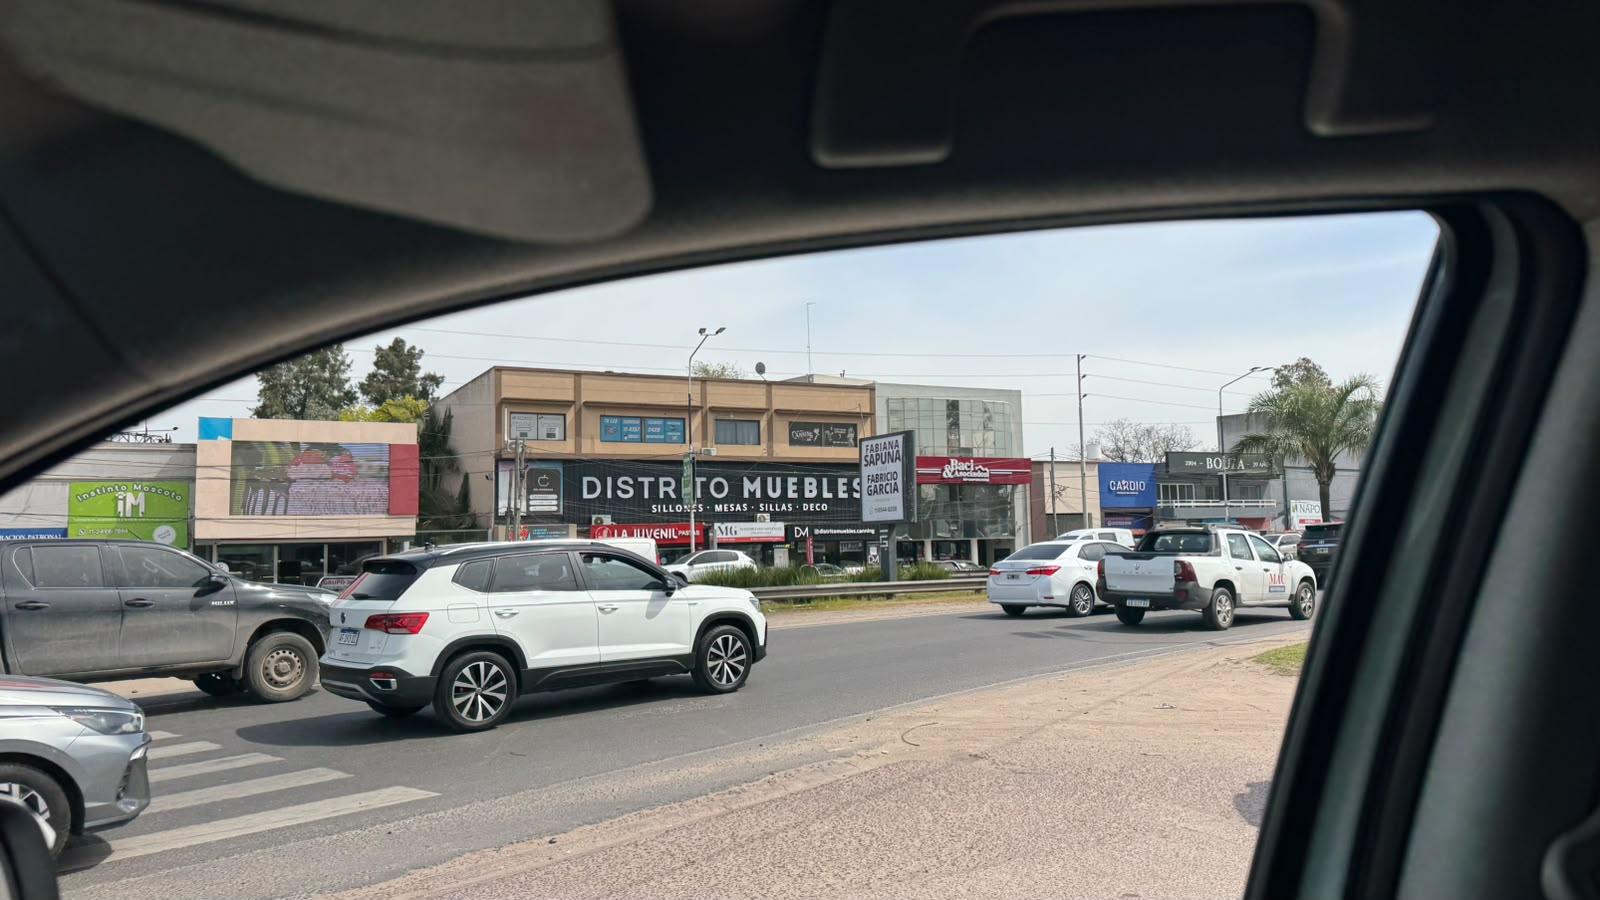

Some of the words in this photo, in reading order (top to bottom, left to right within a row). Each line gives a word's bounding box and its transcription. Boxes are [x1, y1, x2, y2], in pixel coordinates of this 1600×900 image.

[866, 439, 899, 453] FABIANA
[864, 449, 901, 467] SAPUNA
[949, 459, 974, 471] Baci
[867, 471, 898, 484] FABRICIO
[582, 476, 729, 499] DISTRTO
[743, 477, 860, 499] MUEBLES
[867, 481, 899, 496] GARCIA
[1109, 480, 1146, 491] CARDIO
[77, 484, 127, 502] Instinto
[714, 503, 748, 512] MESAS
[759, 503, 793, 512] SILLAS
[803, 503, 828, 511] DECO
[634, 528, 678, 539] JUVENIL
[717, 526, 737, 536] MG
